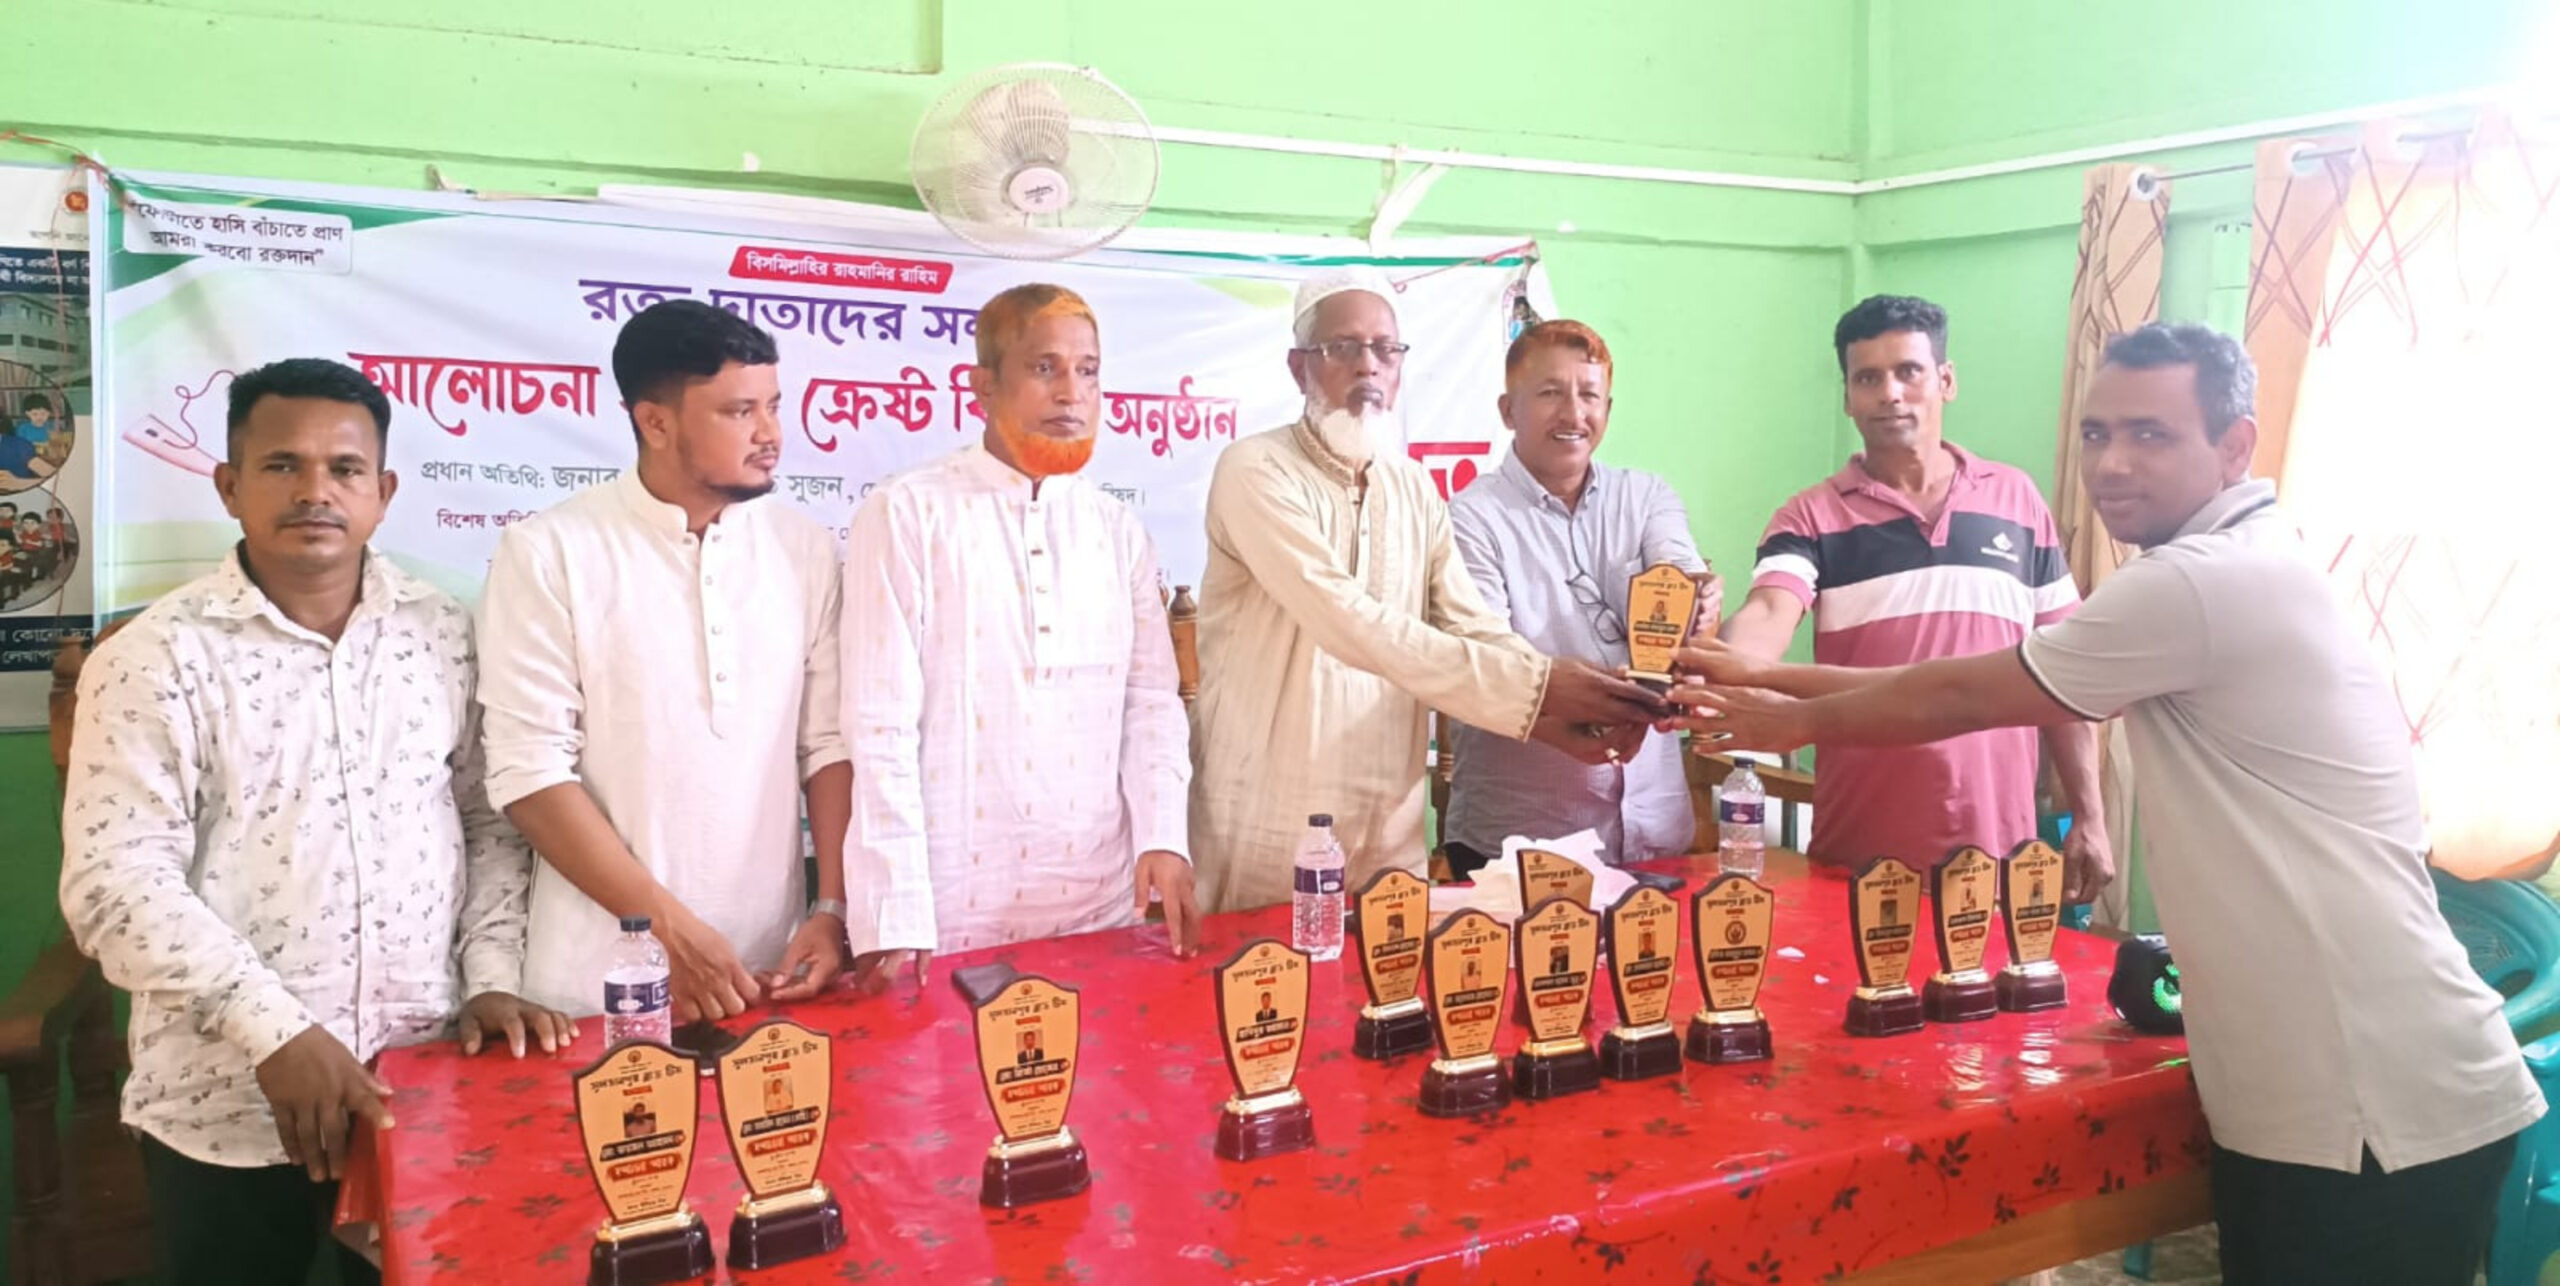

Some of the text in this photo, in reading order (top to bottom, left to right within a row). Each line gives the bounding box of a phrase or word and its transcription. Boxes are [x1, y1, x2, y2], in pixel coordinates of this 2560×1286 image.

[209, 214, 246, 235] হাসি
[252, 216, 308, 239] বাঁচাতে
[312, 224, 343, 242] প্রাণ
[746, 250, 939, 286] বিসমিল্লাহির রাহমানির রাহিম
[708, 288, 907, 346] দাতাদের
[347, 351, 602, 437] আলোচনা
[801, 365, 937, 453] ক্রেষ্ট
[1102, 374, 1240, 459] অনুষ্ঠান
[421, 459, 473, 483] প্রধান
[479, 462, 546, 489] অতিথি:
[436, 507, 486, 529] বিশেষ
